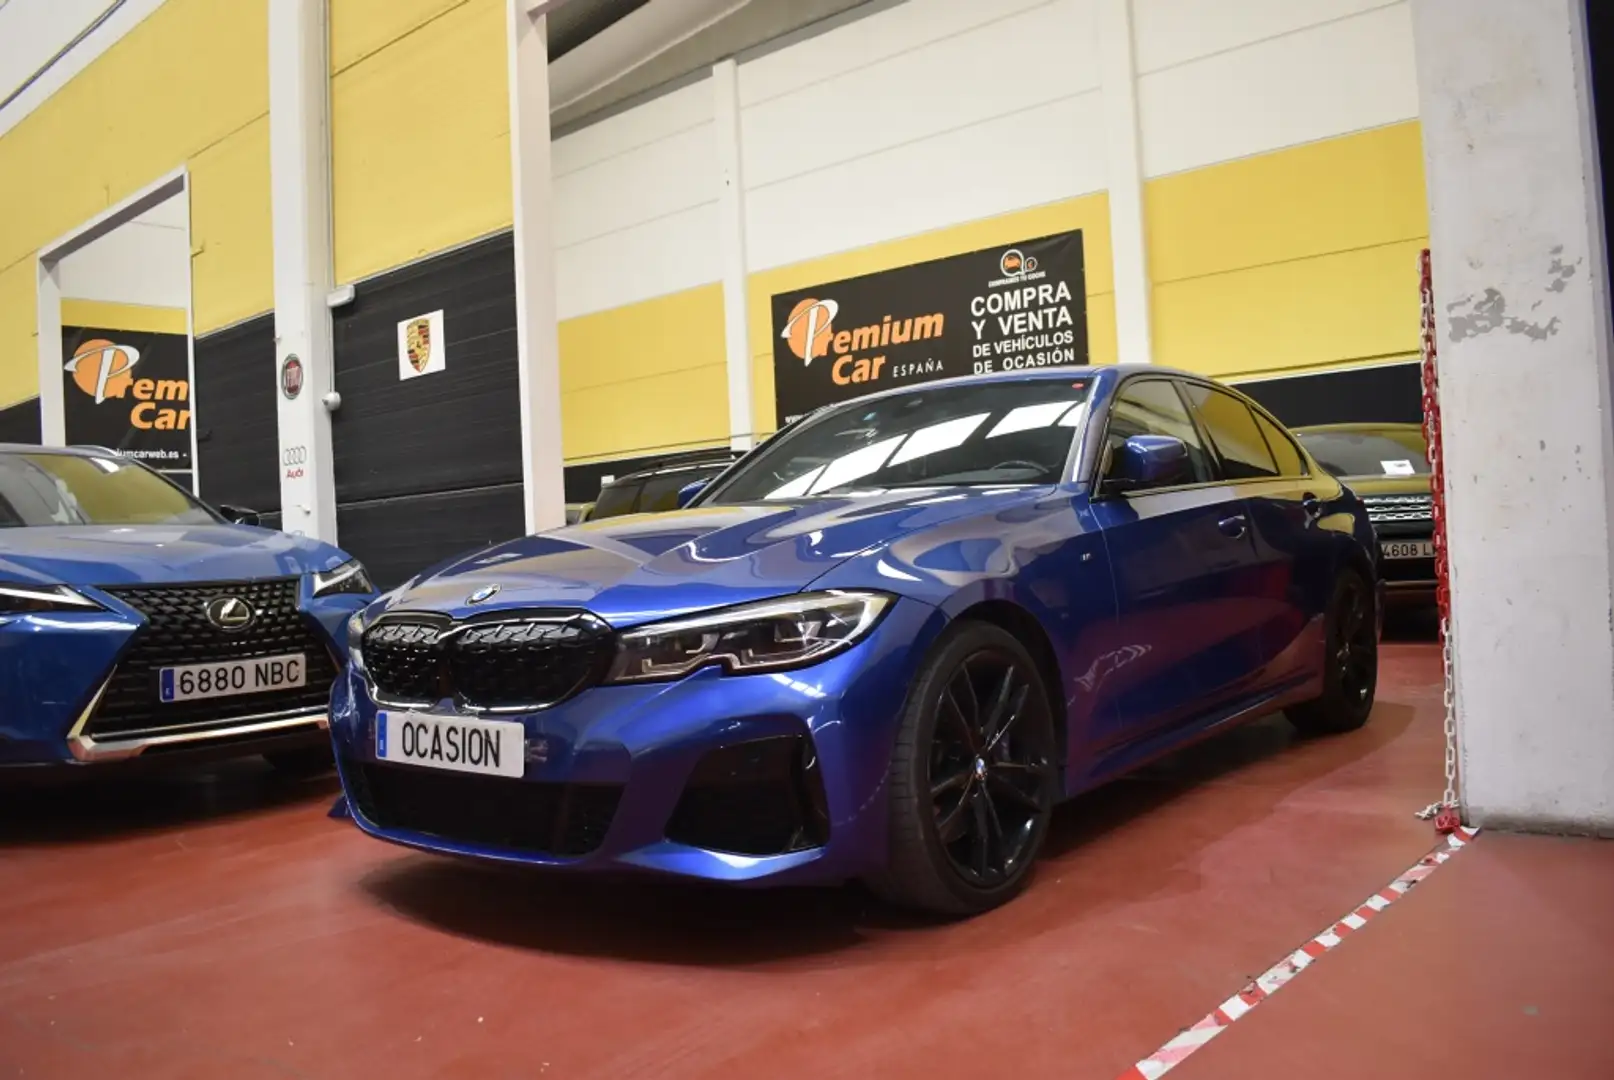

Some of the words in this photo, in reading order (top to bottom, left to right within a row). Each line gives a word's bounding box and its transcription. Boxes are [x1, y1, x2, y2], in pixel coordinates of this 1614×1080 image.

[971, 281, 1072, 317] COMPRA
[781, 299, 944, 367] Premium
[971, 319, 986, 340] Y
[998, 306, 1073, 336] VENTA
[973, 343, 991, 358] DE
[994, 330, 1074, 354] VEHÍCULOS
[831, 354, 886, 385] Car
[893, 358, 944, 378] ESPAÑA
[974, 360, 993, 375] DE
[1002, 347, 1075, 371] OCASIÓN
[130, 402, 191, 430] Car
[1382, 543, 1418, 557] 4608
[180, 665, 245, 695] 6880
[255, 660, 299, 687] NBC
[402, 721, 500, 768] OCASION
